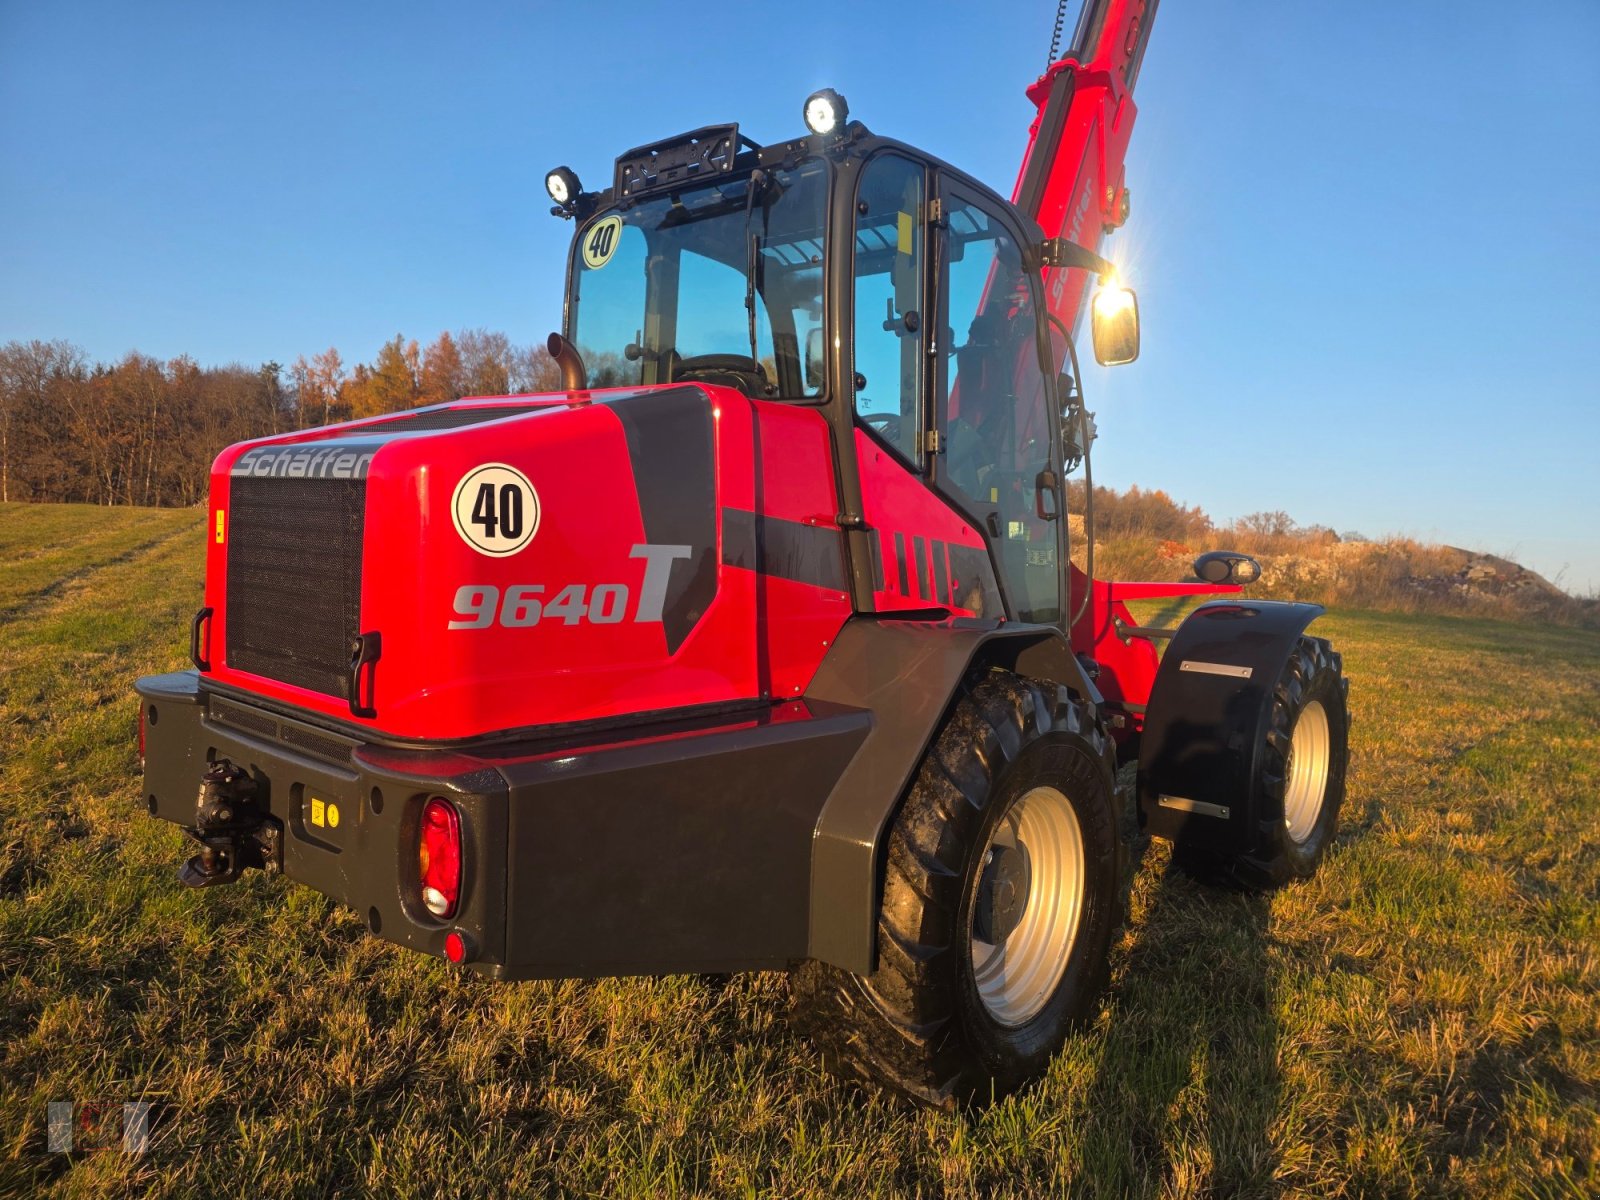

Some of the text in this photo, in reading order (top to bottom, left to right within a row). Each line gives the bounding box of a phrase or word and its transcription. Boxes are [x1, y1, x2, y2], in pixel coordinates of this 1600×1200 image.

[589, 223, 616, 258] 40
[230, 447, 376, 478] Schäffer
[471, 483, 523, 539] 40
